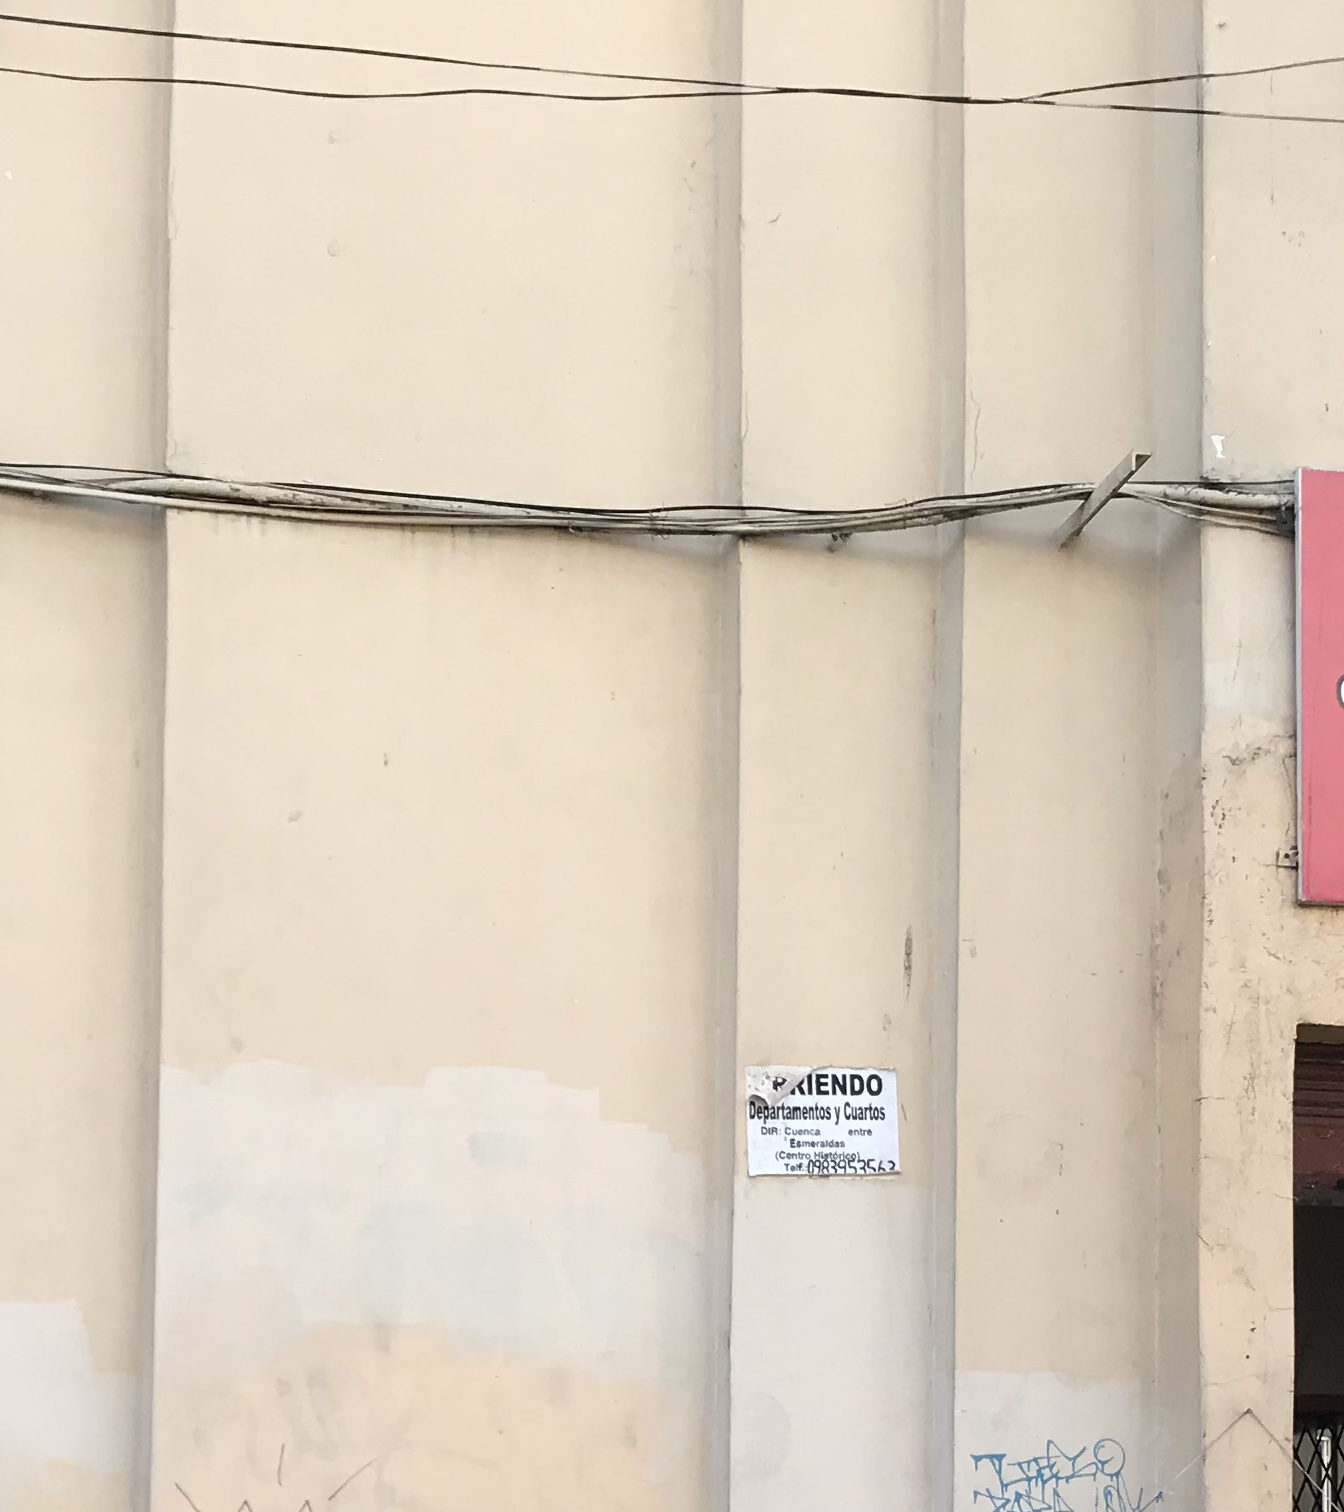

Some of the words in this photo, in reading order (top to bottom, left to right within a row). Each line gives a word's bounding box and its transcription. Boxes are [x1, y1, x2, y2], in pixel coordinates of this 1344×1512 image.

[749, 1101, 831, 1124] Departamentos
[835, 1106, 841, 1125] y
[843, 1101, 886, 1121] Cuartos
[785, 1127, 821, 1136] Cuenca
[848, 1127, 873, 1136] entre
[790, 1138, 846, 1148] Esmeraldas
